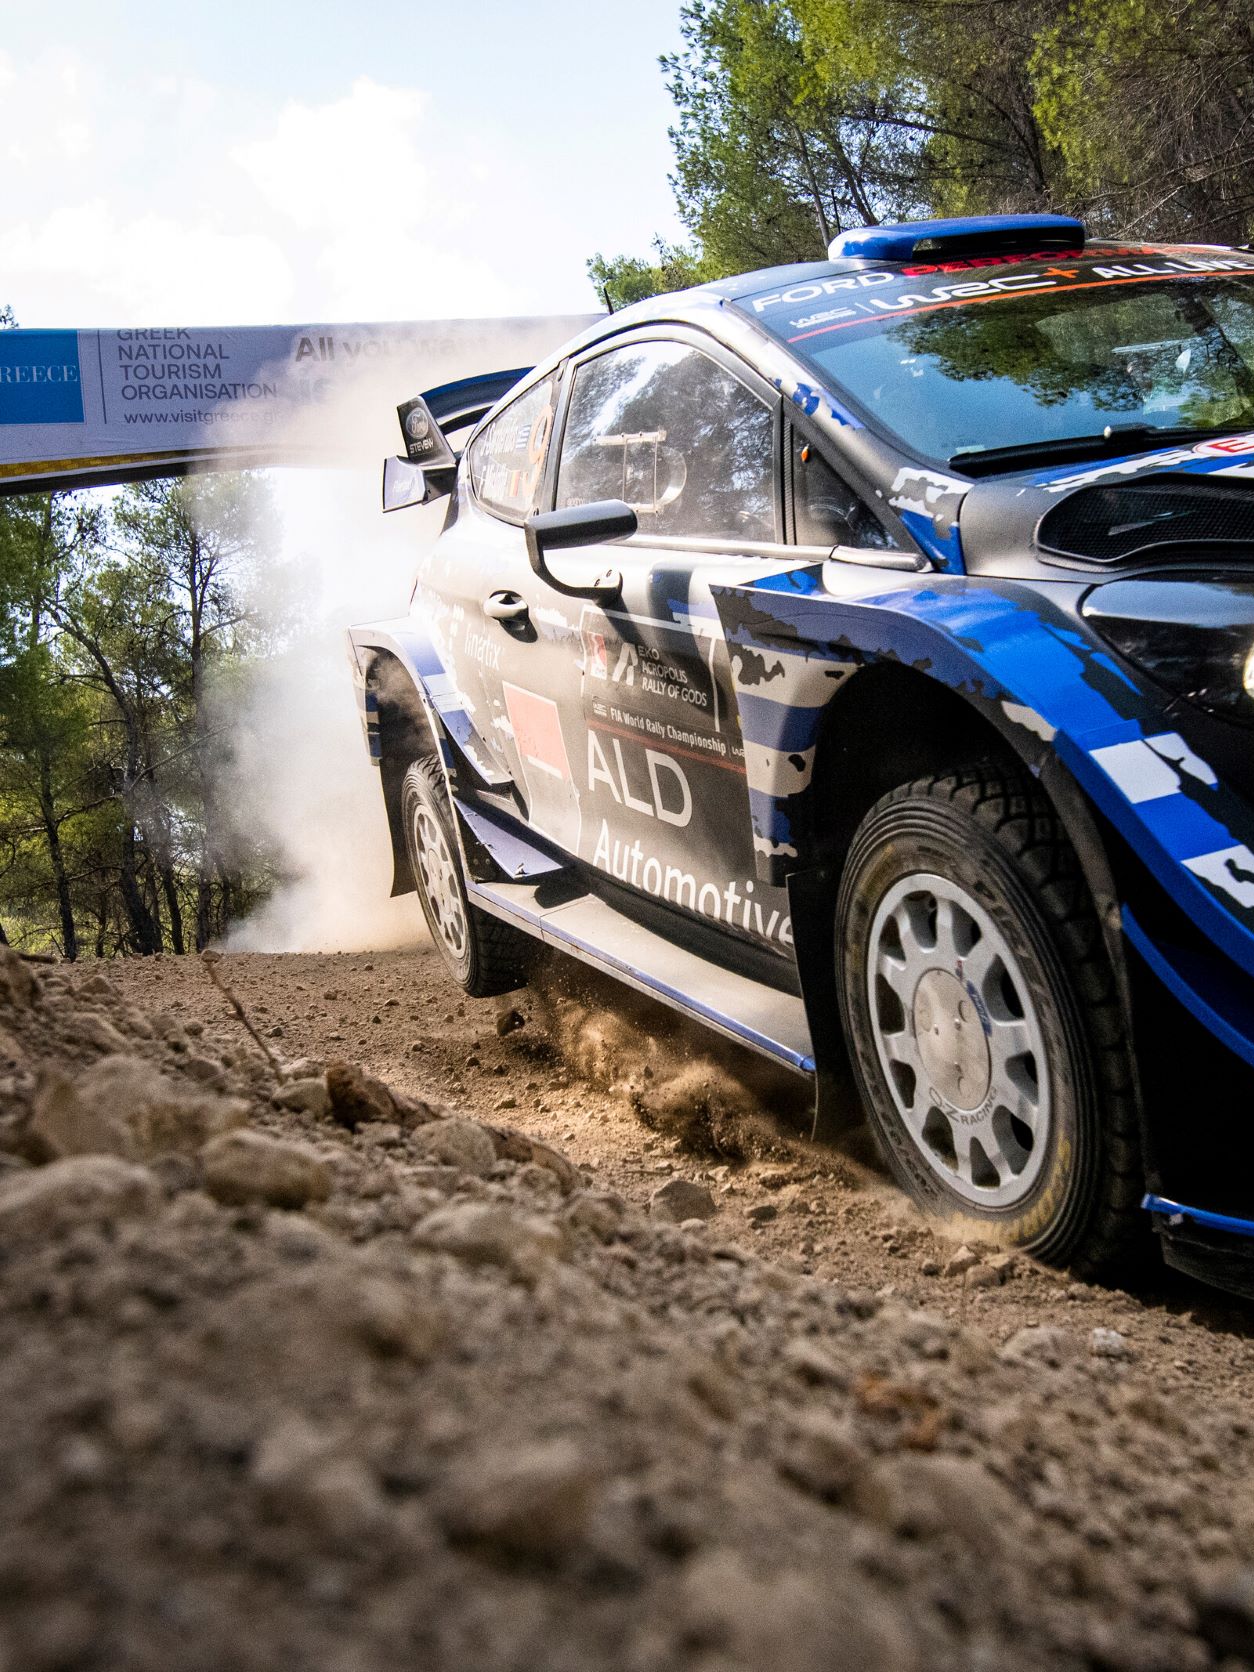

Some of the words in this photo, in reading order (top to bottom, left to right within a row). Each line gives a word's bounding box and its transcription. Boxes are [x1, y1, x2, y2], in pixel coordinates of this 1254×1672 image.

[751, 271, 895, 313] FORD
[116, 328, 192, 341] GREEK
[117, 343, 230, 361] NATIONAL
[295, 336, 336, 363] All
[119, 363, 222, 381] TOURISM
[121, 383, 278, 401] ORGANISATION
[637, 645, 660, 661] EKO
[641, 662, 688, 684] ACROPOLIS
[641, 676, 667, 696] RALLY
[667, 684, 681, 700] OF
[681, 688, 708, 707] GODS
[610, 707, 623, 723] FIA
[623, 711, 645, 730] World
[645, 717, 666, 739] Rally
[666, 724, 727, 756] Championship
[587, 728, 693, 828] ALD
